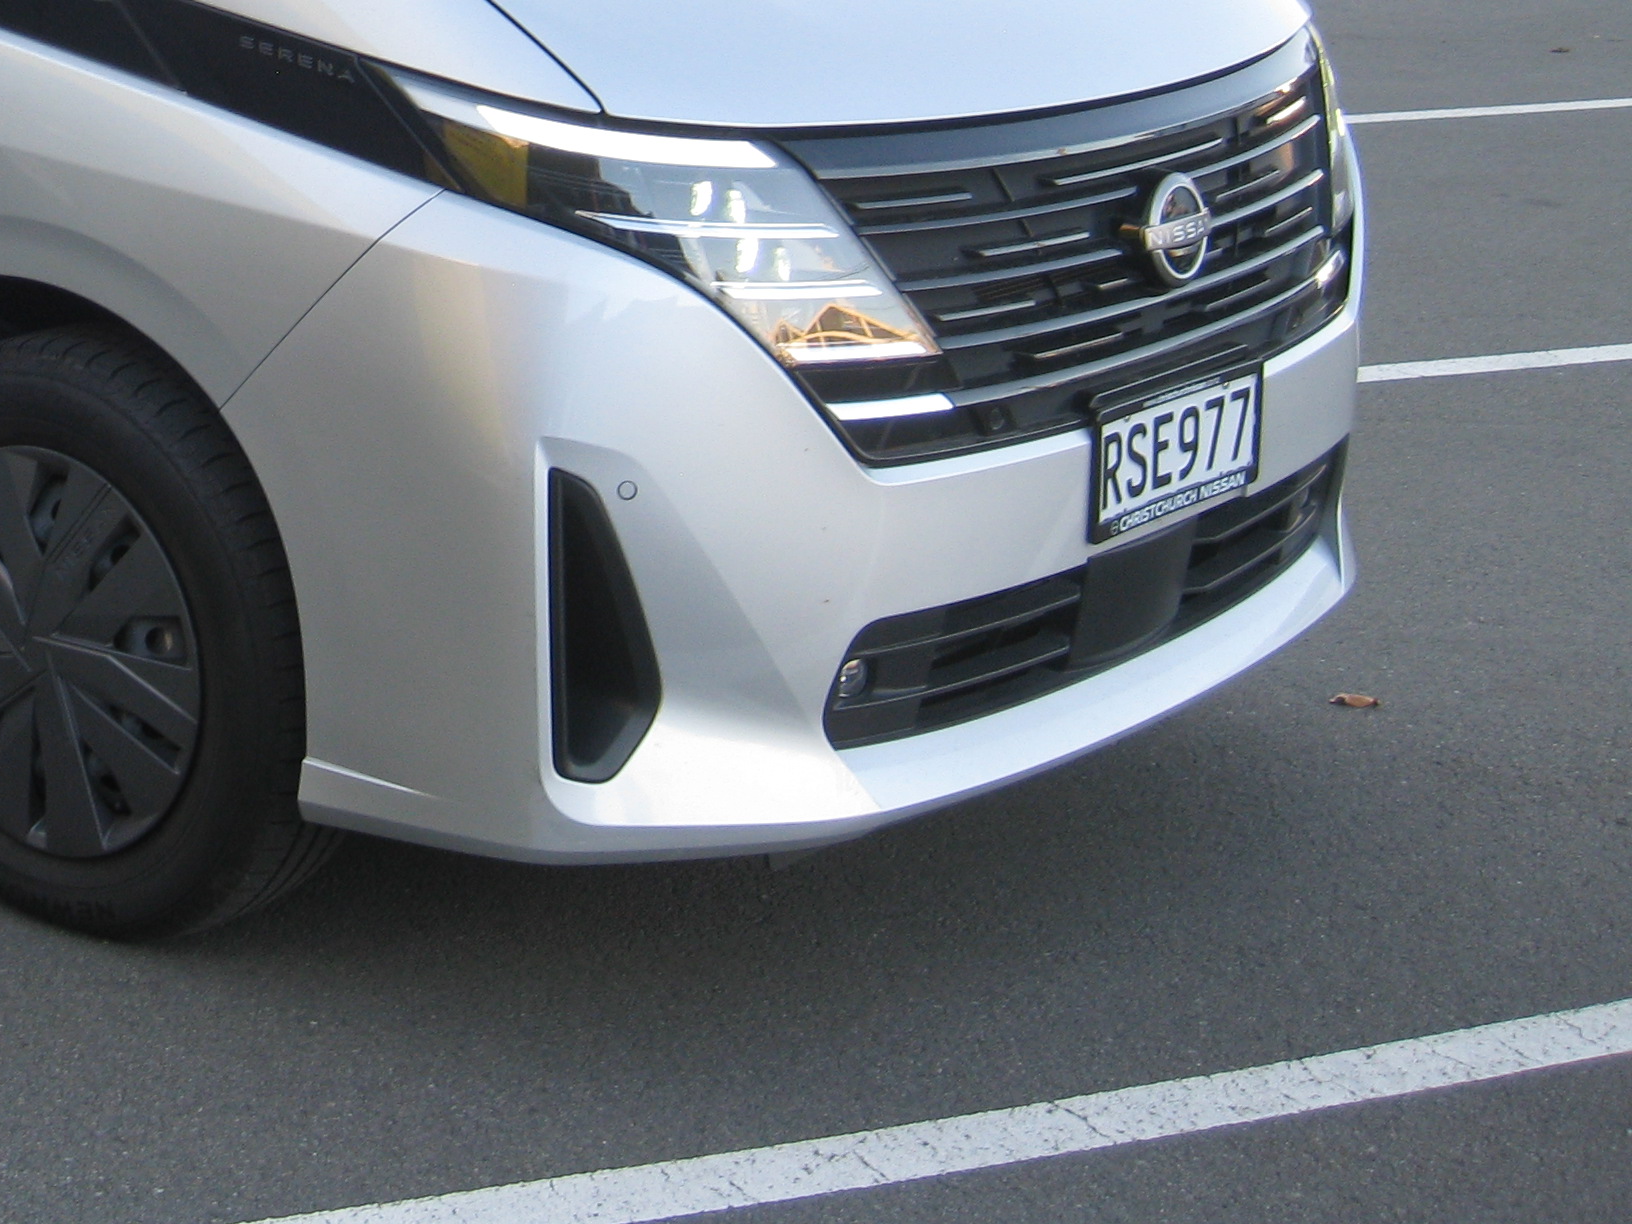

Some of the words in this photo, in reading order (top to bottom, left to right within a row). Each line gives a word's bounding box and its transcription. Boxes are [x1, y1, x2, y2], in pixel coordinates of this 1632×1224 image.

[239, 35, 355, 84] SERENA
[1149, 217, 1209, 246] NISSA
[1101, 386, 1251, 510] RSE977
[1119, 486, 1198, 532] CHRISTCHURCH
[1199, 470, 1247, 500] NISSAN
